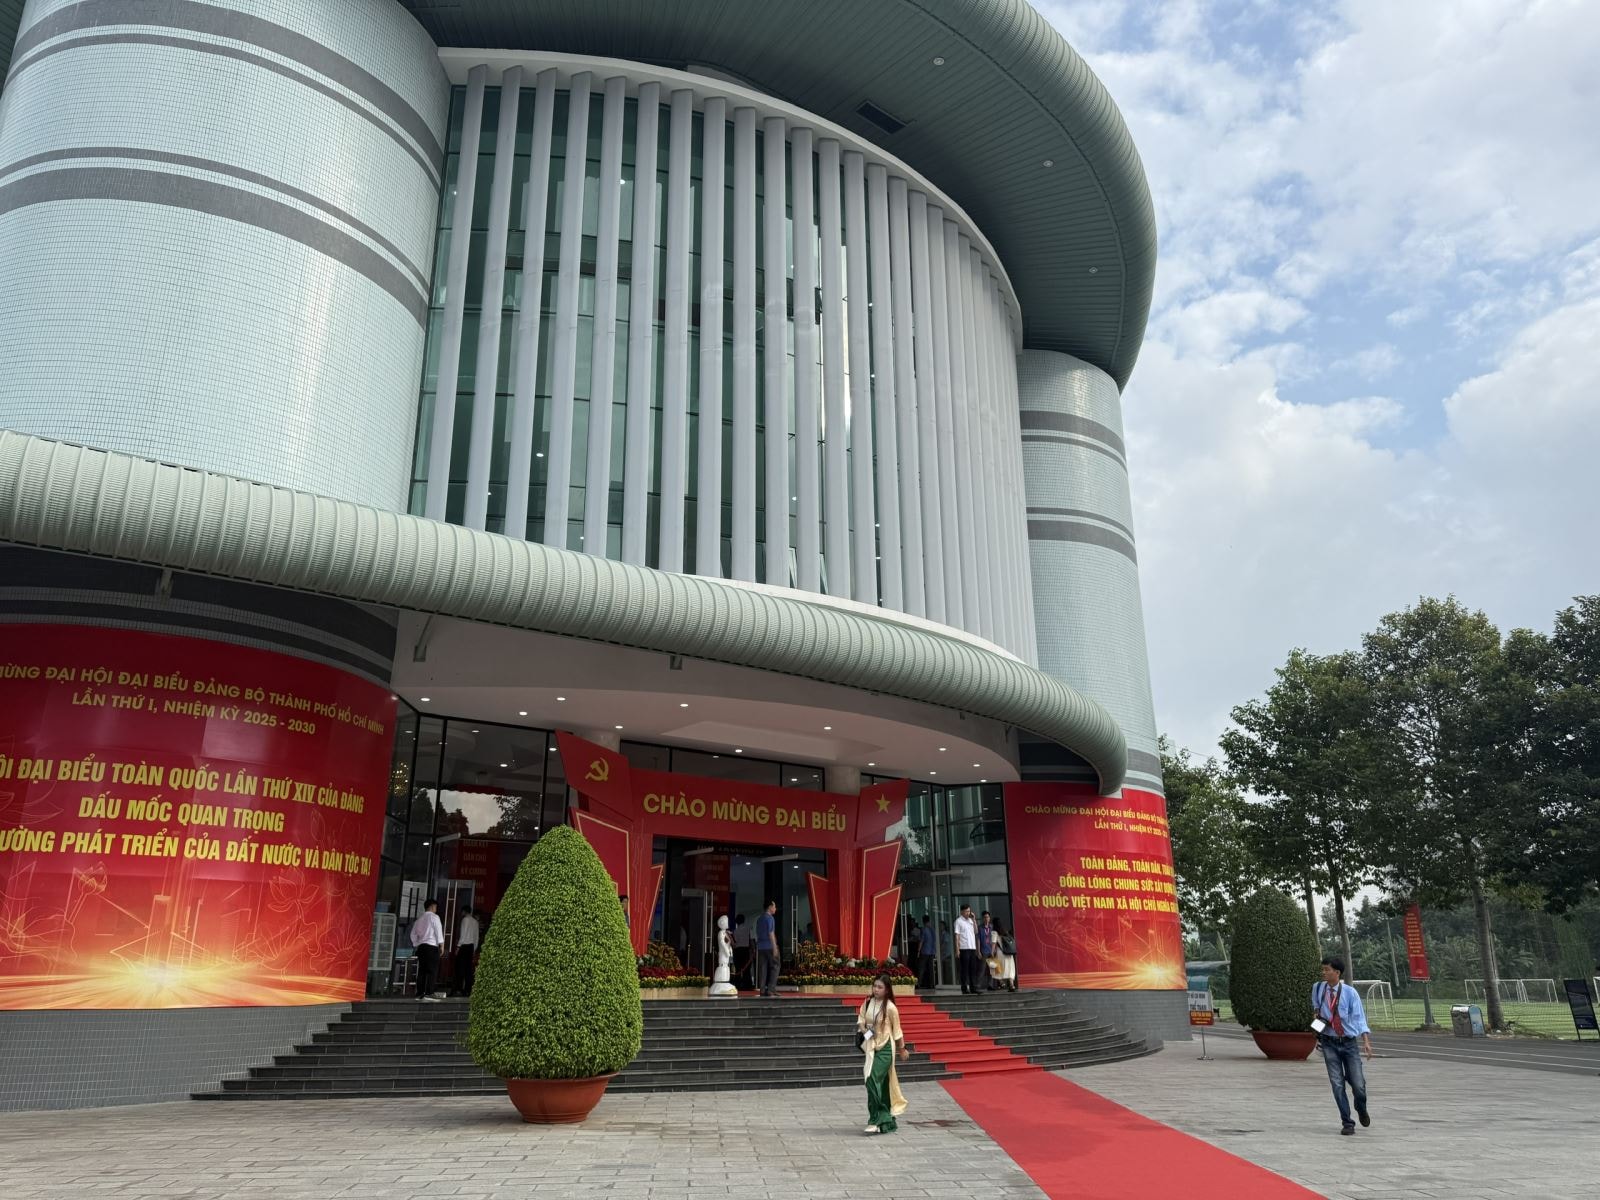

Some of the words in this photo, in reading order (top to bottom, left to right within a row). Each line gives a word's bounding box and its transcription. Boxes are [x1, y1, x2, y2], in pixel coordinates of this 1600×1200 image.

[45, 667, 76, 684] ĐẠI
[80, 666, 113, 686] HỘI
[118, 671, 149, 689] ĐẠI
[153, 670, 189, 691] BIỂU
[193, 677, 241, 698] ĐẢNG
[244, 687, 266, 705] BỘ
[269, 692, 311, 711] THÀNH
[314, 702, 337, 718] PHỐ
[353, 714, 368, 729] CHÍ
[72, 687, 106, 707] LẦN
[111, 694, 145, 710] THỨ
[164, 700, 215, 719] NHIỆM
[220, 705, 239, 721] KỲ
[243, 710, 277, 727] 2025
[288, 719, 316, 735] 2030
[17, 759, 53, 784] ĐẠI
[57, 753, 106, 782] BIỂU
[111, 760, 164, 786] TOÀN
[168, 763, 219, 790] QUỐC
[223, 767, 258, 796] LẦN
[262, 776, 293, 800] THỨ
[293, 781, 317, 804] XIV
[317, 782, 338, 808] CỦA
[340, 788, 365, 814] ĐẢNG
[78, 790, 122, 819] DẤU
[126, 794, 173, 822] MỐC
[177, 803, 228, 827] QUAN
[233, 807, 285, 834] TRỌNG
[643, 791, 705, 817] CHÀO
[712, 798, 770, 826] MỪNG
[775, 808, 806, 832] ĐẠI
[811, 804, 847, 832] BIỂU
[60, 829, 116, 855] PHÁT
[121, 827, 179, 858] TRIỂN
[183, 832, 221, 860] CỦA
[225, 835, 259, 863] ĐẤT
[262, 841, 302, 867] NƯỚC
[305, 845, 319, 869] VÀ
[322, 848, 343, 873] DÂN
[345, 851, 359, 877] TỘC
[1080, 855, 1104, 870] TOÀN
[1042, 890, 1069, 909] QUỐC
[1071, 894, 1091, 911] VIỆT
[1093, 896, 1115, 909] NAM
[1113, 878, 1140, 891] CHUNG
